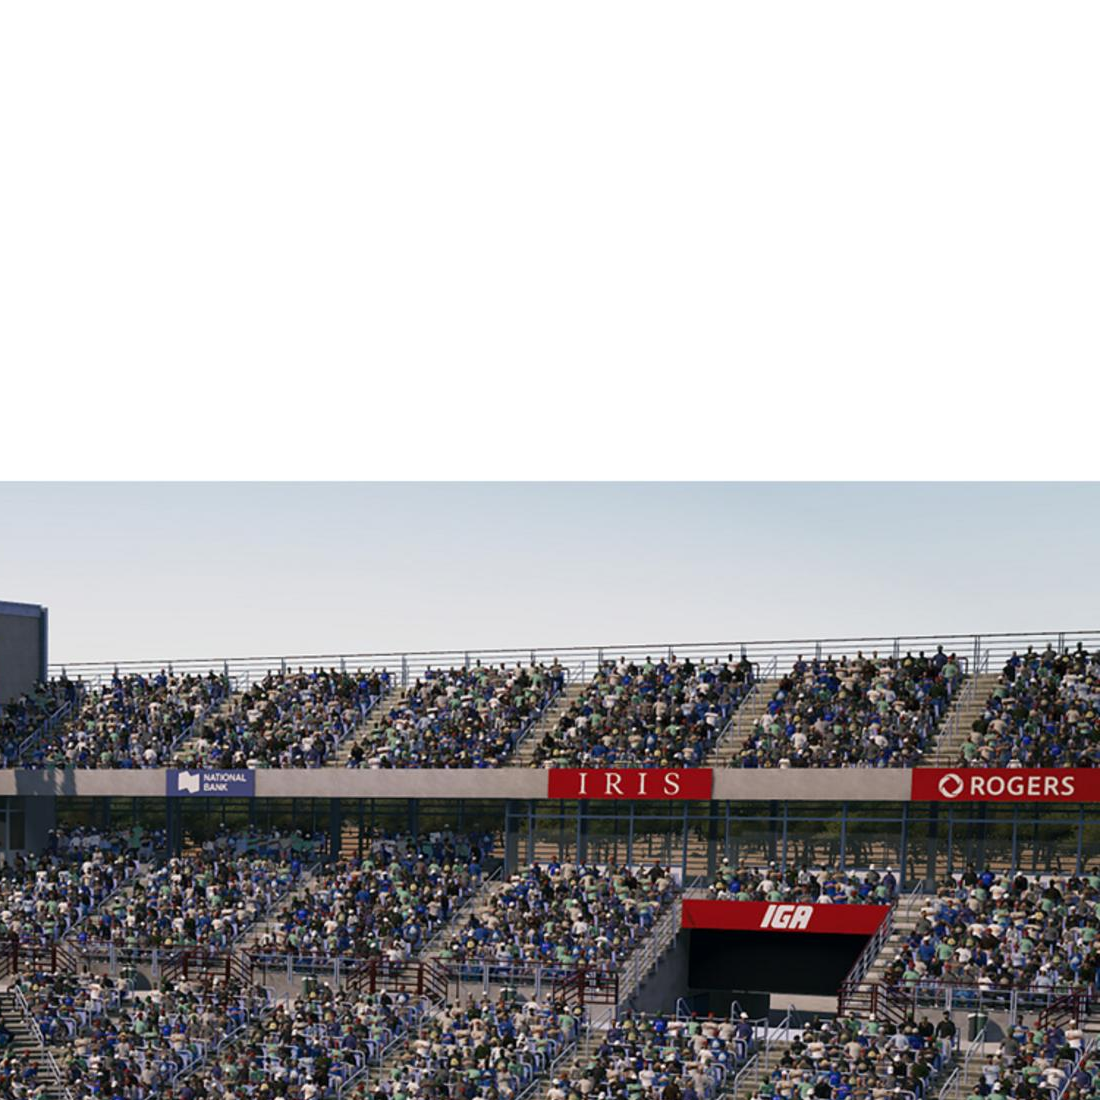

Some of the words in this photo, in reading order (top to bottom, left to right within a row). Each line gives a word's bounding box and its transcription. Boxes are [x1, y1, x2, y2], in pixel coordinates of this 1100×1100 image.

[203, 773, 248, 783] NATIONAL
[203, 783, 229, 792] BANK
[578, 772, 680, 796] IRIS
[970, 776, 1075, 796] ROGERS
[760, 904, 814, 930] IGA
